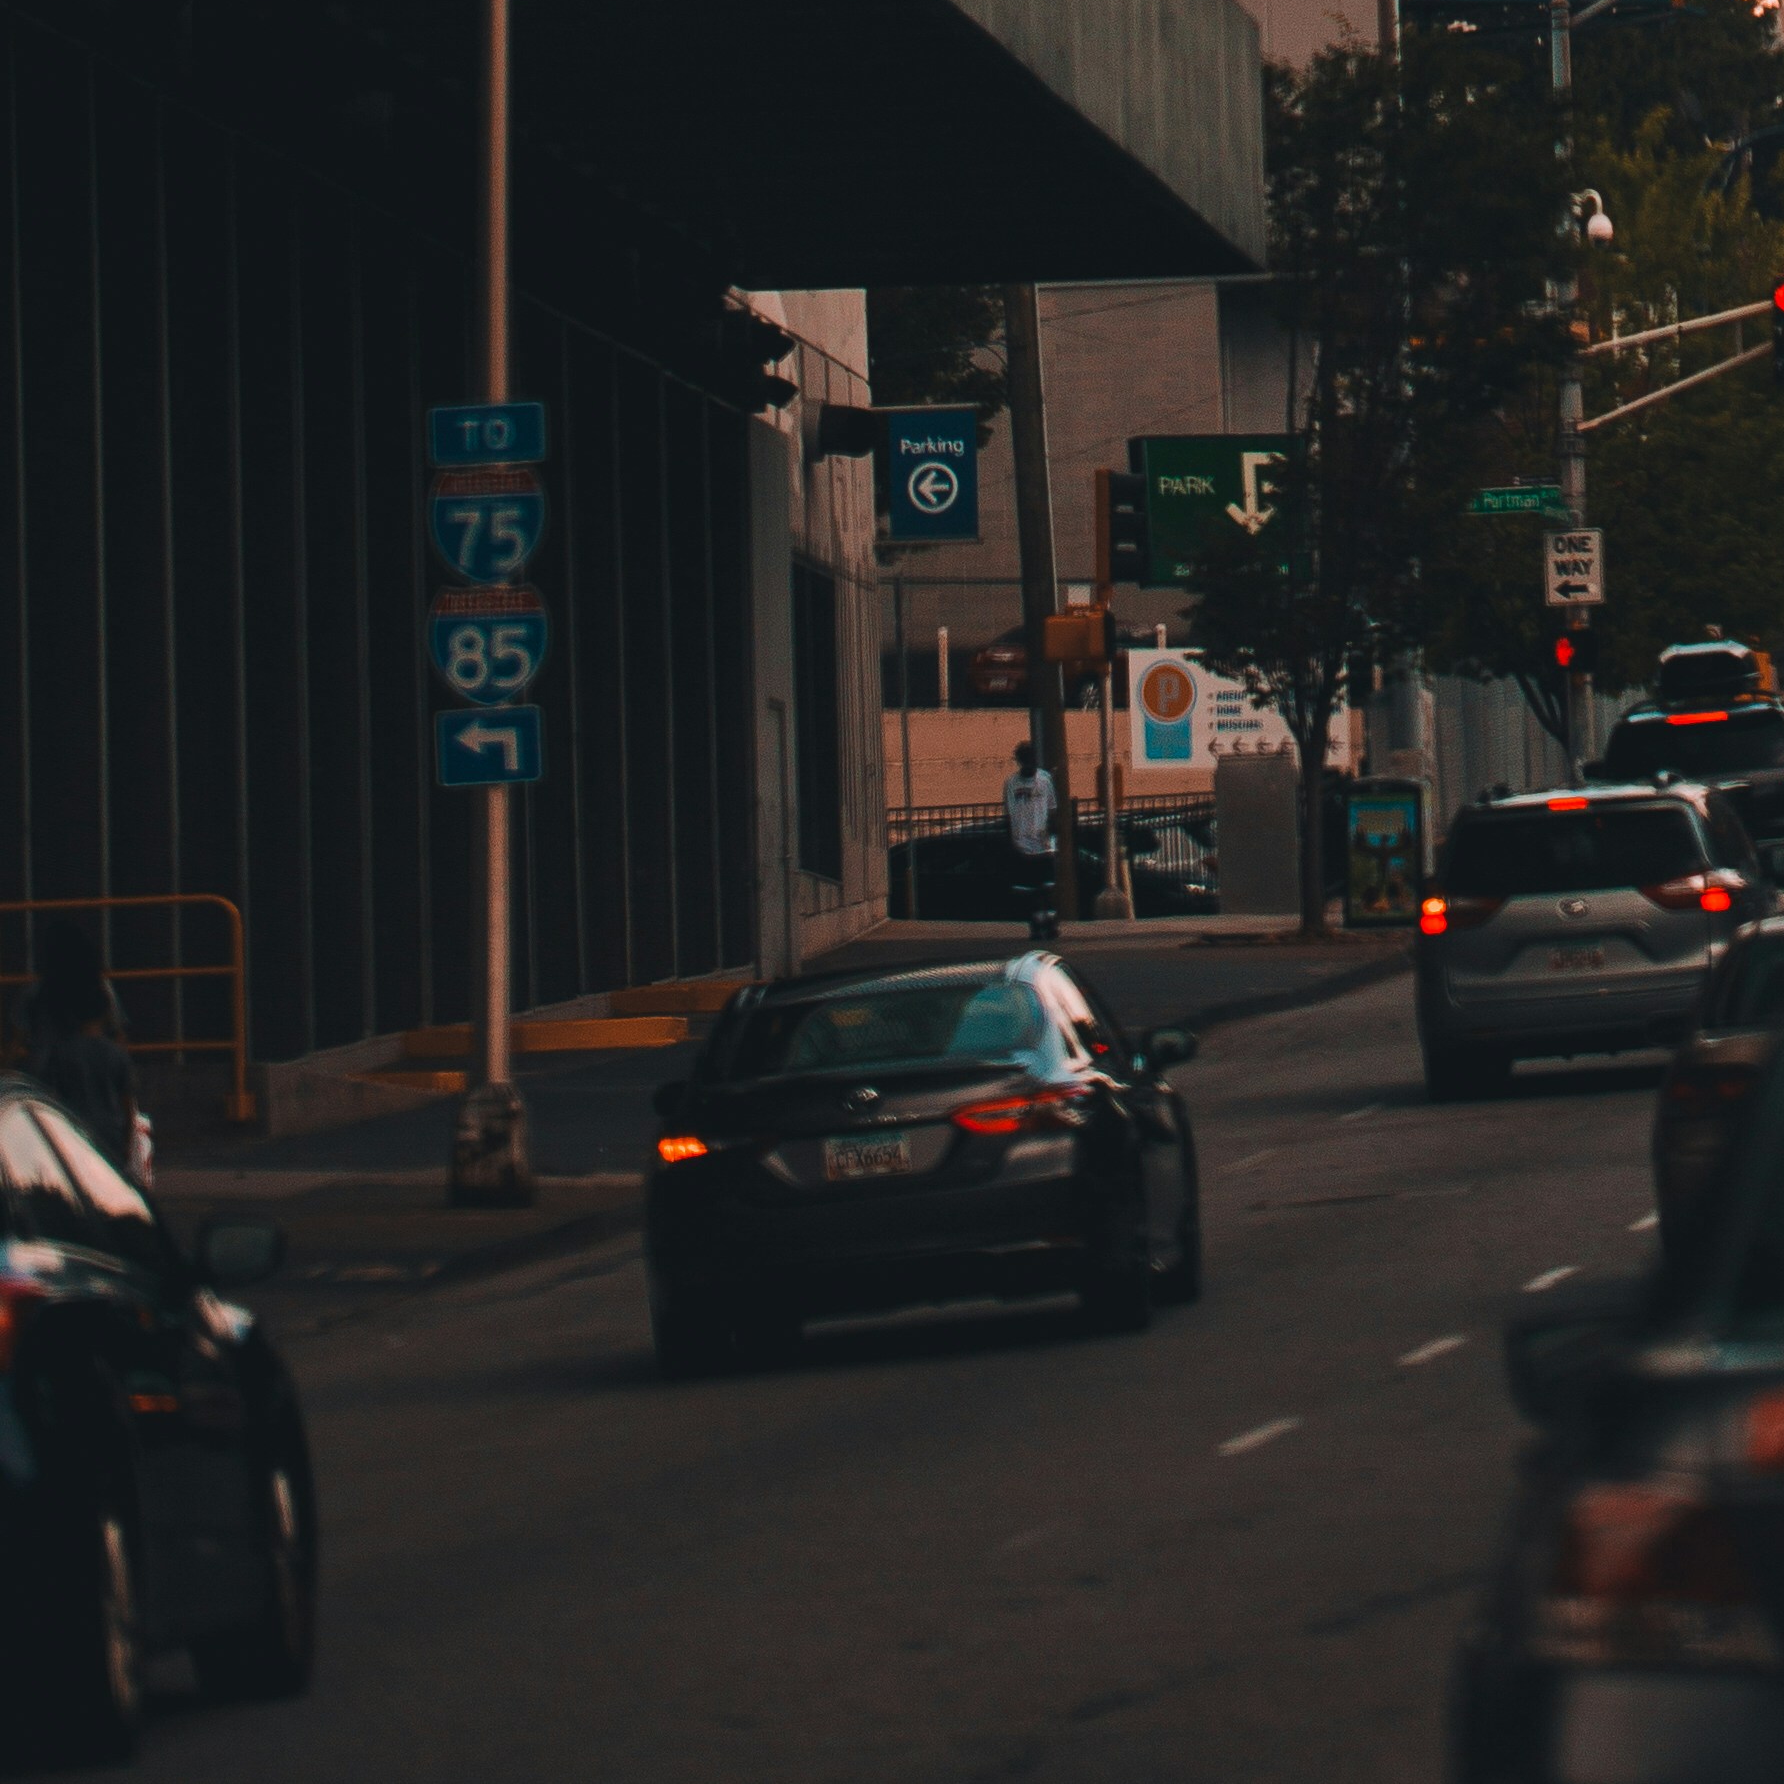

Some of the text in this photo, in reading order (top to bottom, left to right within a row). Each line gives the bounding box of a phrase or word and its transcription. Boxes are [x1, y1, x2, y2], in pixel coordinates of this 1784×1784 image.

[458, 418, 509, 450] TO
[900, 435, 964, 457] Parking
[1158, 476, 1216, 496] PARK
[449, 510, 526, 570] 75
[1554, 536, 1592, 553] ONE
[1554, 560, 1594, 576] WAY
[447, 625, 531, 689] 85
